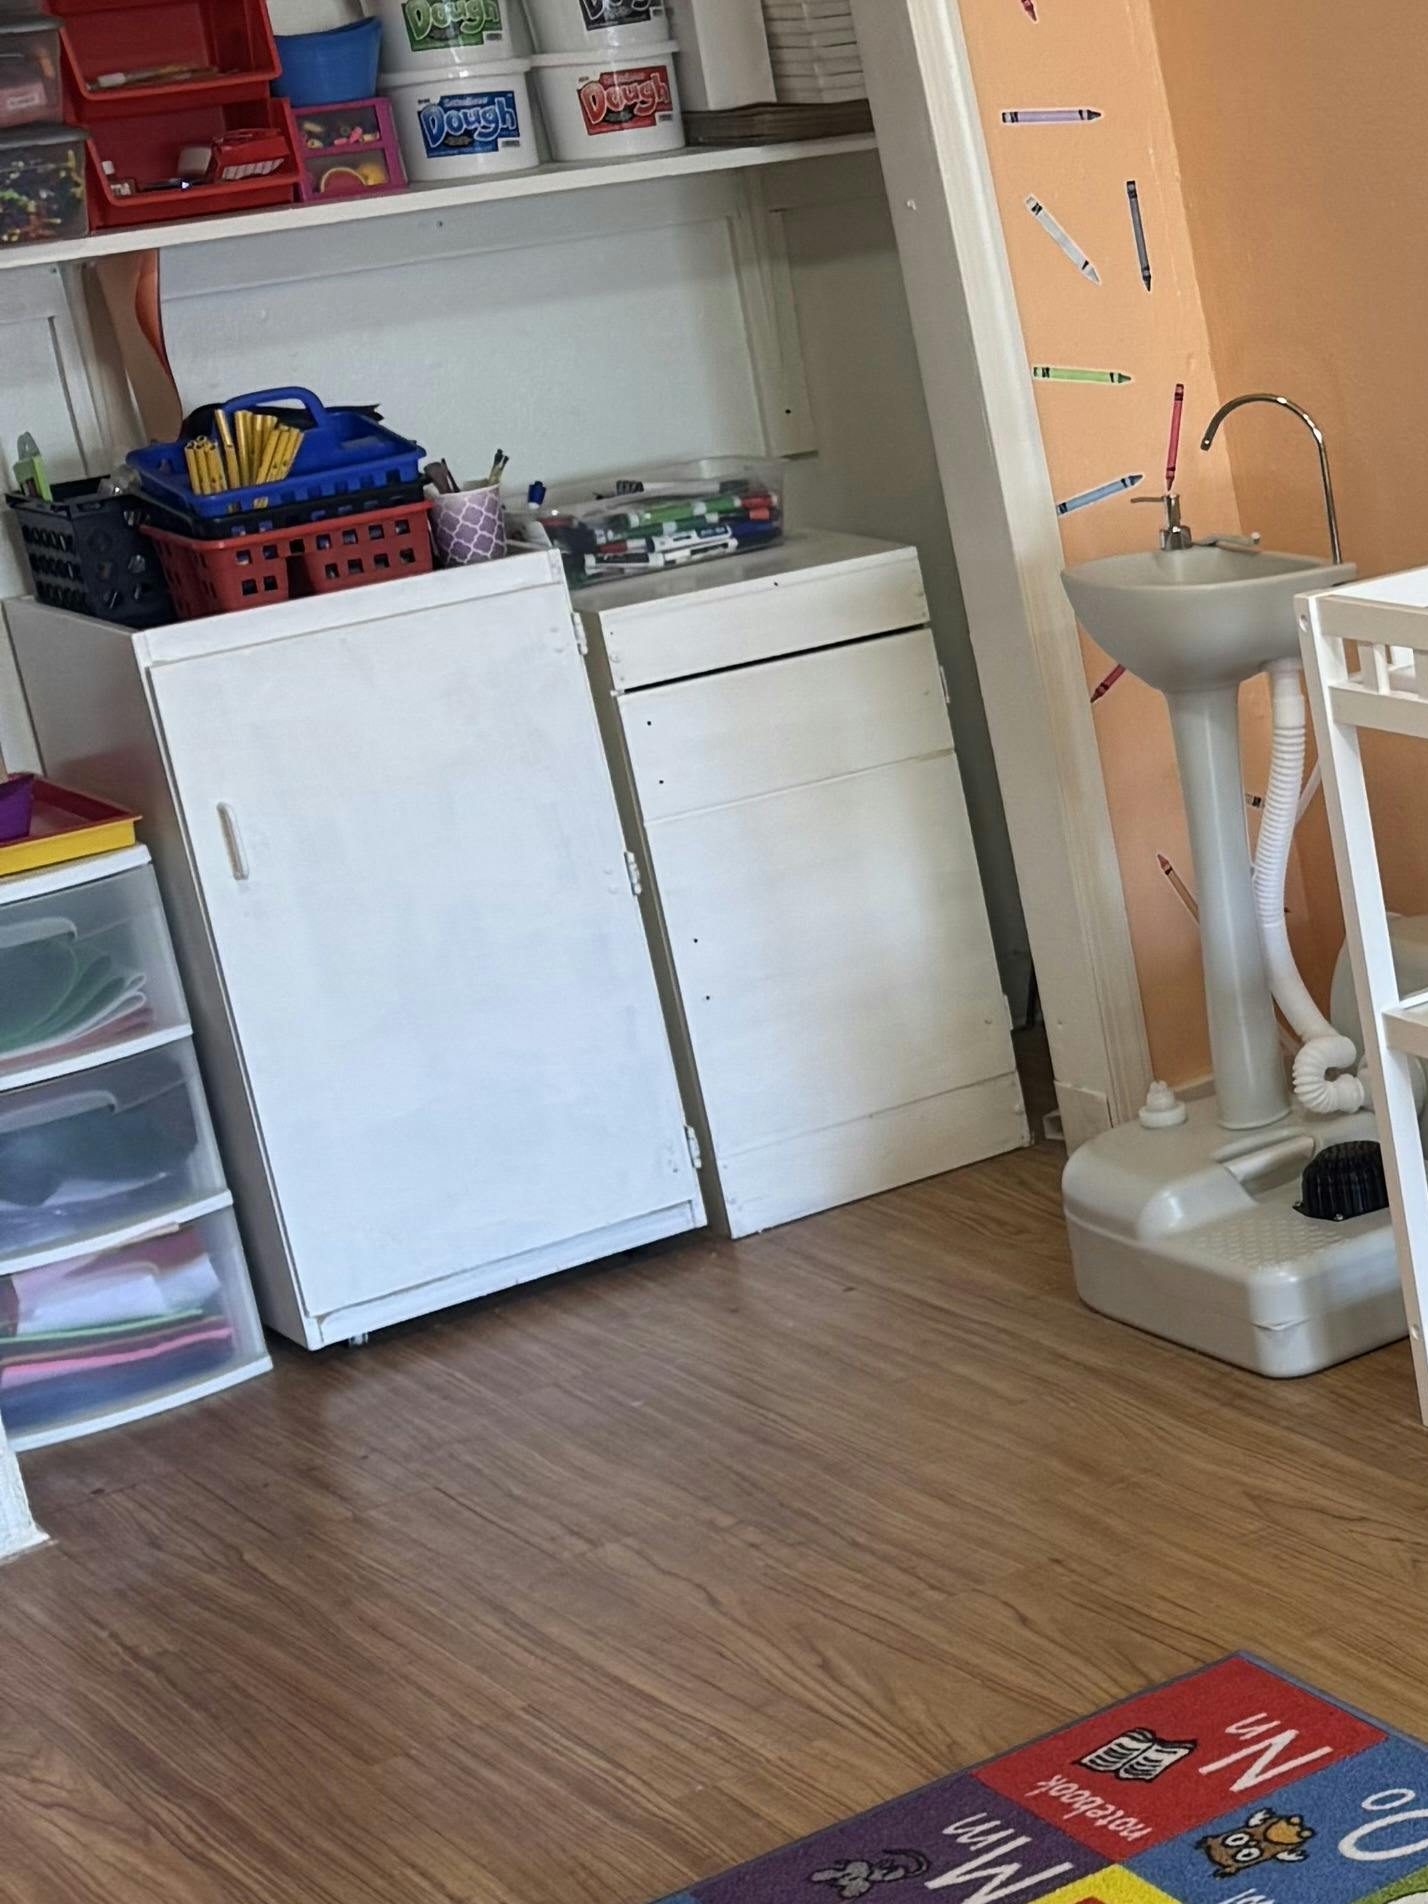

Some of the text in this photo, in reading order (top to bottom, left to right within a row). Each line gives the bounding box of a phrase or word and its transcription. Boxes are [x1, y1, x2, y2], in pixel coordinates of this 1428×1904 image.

[421, 97, 516, 148] Dough
[580, 73, 670, 124] Dough
[1026, 1774, 1153, 1842] notebook
